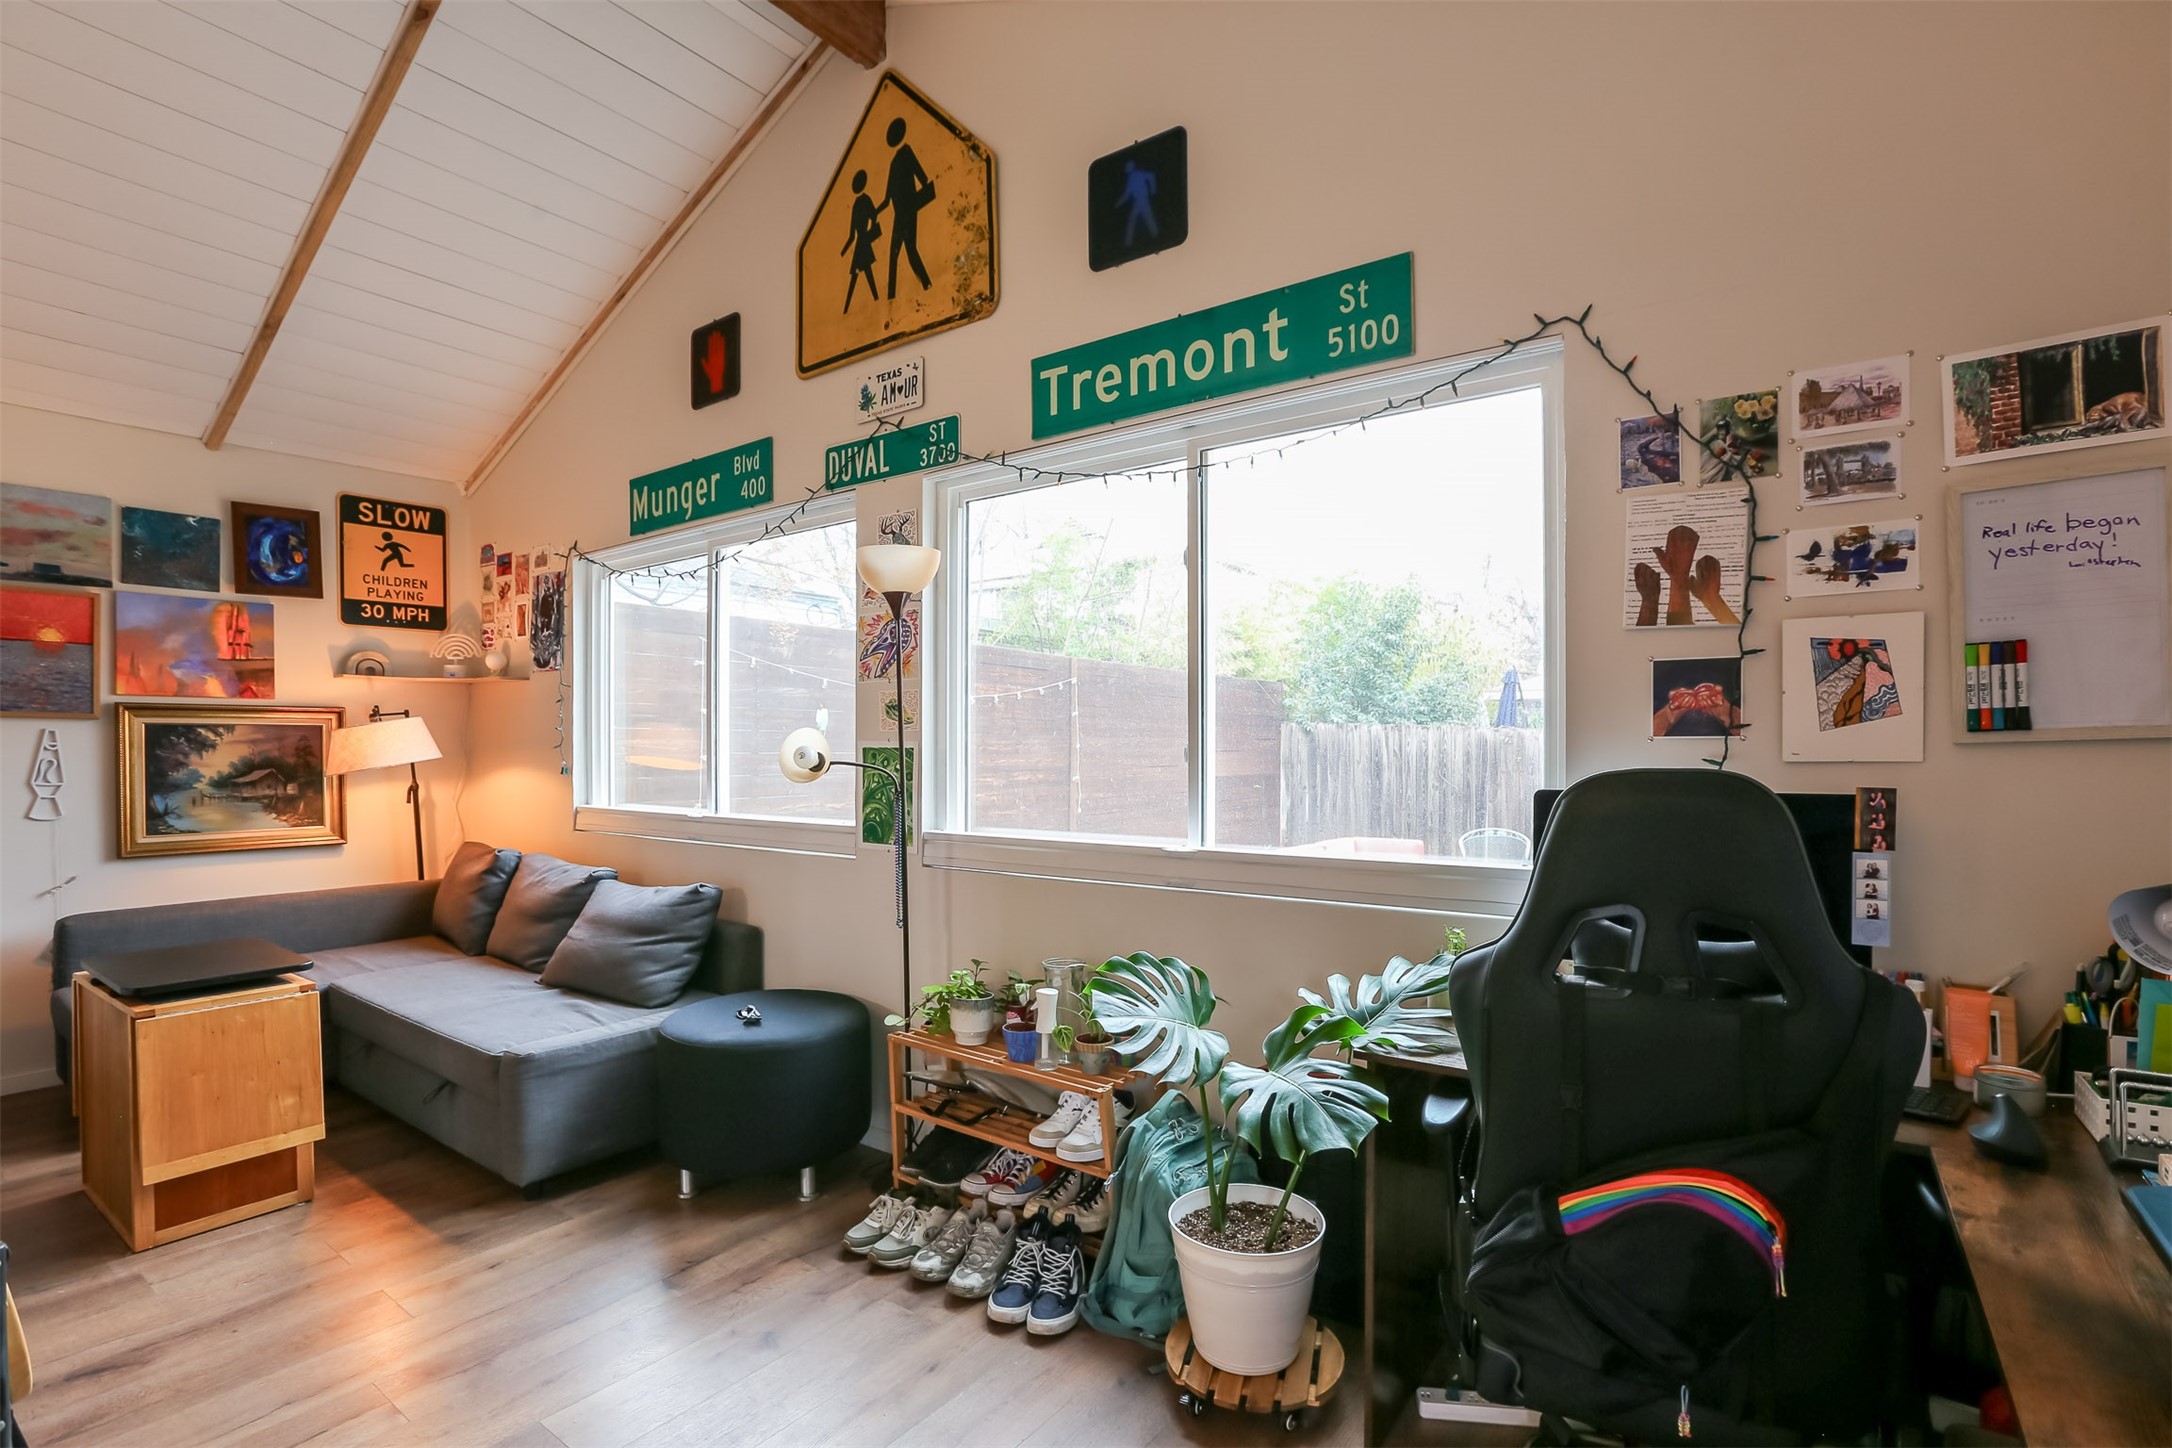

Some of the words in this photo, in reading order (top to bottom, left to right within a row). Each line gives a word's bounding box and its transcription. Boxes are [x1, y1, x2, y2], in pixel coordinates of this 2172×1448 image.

[1040, 307, 1288, 416] Tremont
[1339, 280, 1369, 314] St
[1328, 314, 1399, 358] 5100
[876, 368, 902, 383] TEXAS
[829, 439, 889, 484] DUVAL
[929, 421, 946, 442] ST
[632, 471, 720, 521] Munger
[734, 450, 761, 476] Blvd
[740, 476, 766, 500] 400
[358, 502, 431, 530] SLOW
[1982, 523, 2016, 539] Real
[2026, 519, 2056, 533] life
[2066, 513, 2141, 535] began
[363, 574, 428, 589] CHILDREN
[367, 587, 424, 602] PLAYING
[360, 603, 385, 618] 30
[393, 606, 430, 622] MPH
